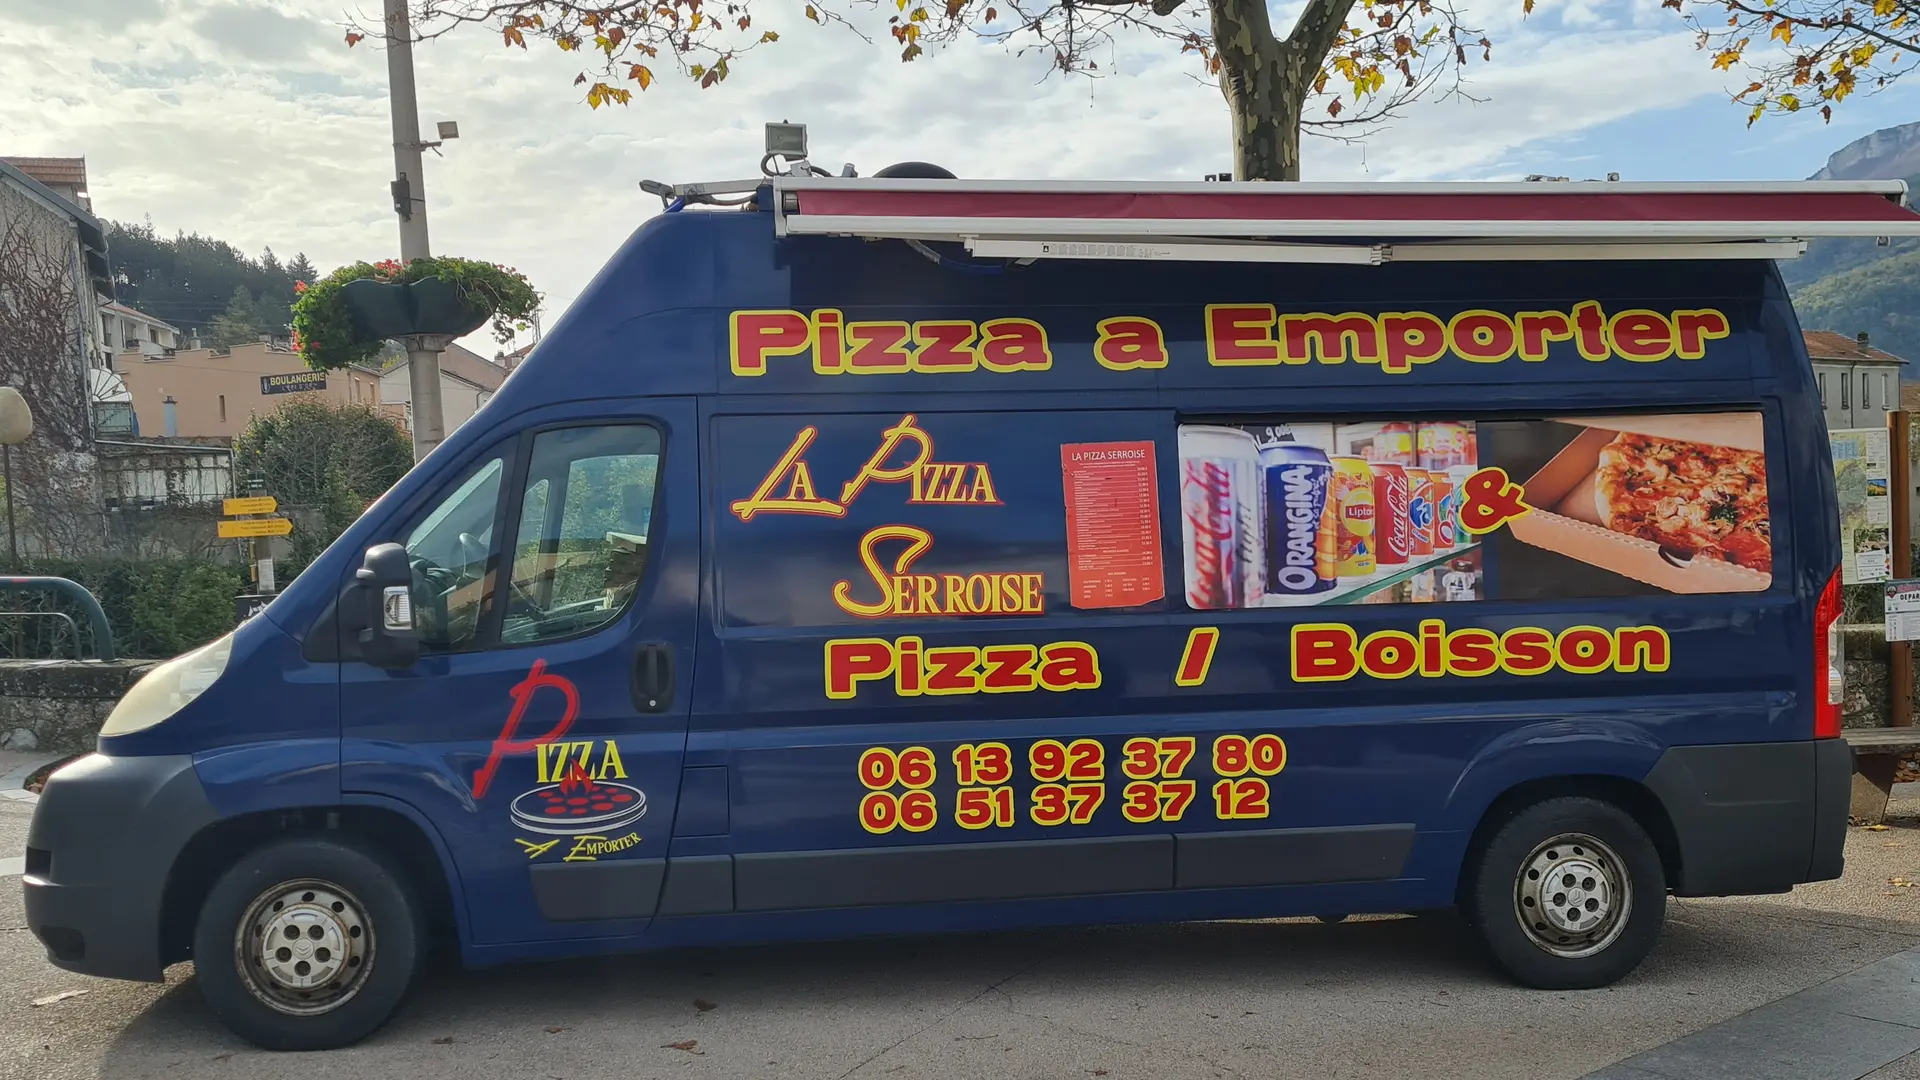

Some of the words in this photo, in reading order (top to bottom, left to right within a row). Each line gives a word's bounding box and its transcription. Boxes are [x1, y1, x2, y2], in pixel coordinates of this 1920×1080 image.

[729, 308, 1052, 376] Pizza
[1095, 316, 1168, 370] a
[1206, 301, 1729, 374] Emporter
[270, 372, 326, 386] BOULANGERIE
[1071, 452, 1082, 461] LA
[1083, 451, 1106, 461] PIZZA
[1107, 449, 1146, 460] SERROISE
[1278, 465, 1317, 591] ORANGINA
[1462, 466, 1532, 535] &
[825, 635, 1102, 700] Pizza
[1175, 627, 1219, 686] /
[1290, 619, 1671, 682] Boisson
[858, 747, 937, 790] 06
[953, 742, 1013, 785] 13
[1029, 739, 1105, 782] 92
[1122, 737, 1195, 780] 37
[1213, 734, 1287, 777] 80
[858, 788, 938, 834] 06
[955, 786, 1015, 829] 51
[1029, 783, 1105, 826] 37
[1121, 780, 1196, 823] 37
[1213, 777, 1270, 819] 12
